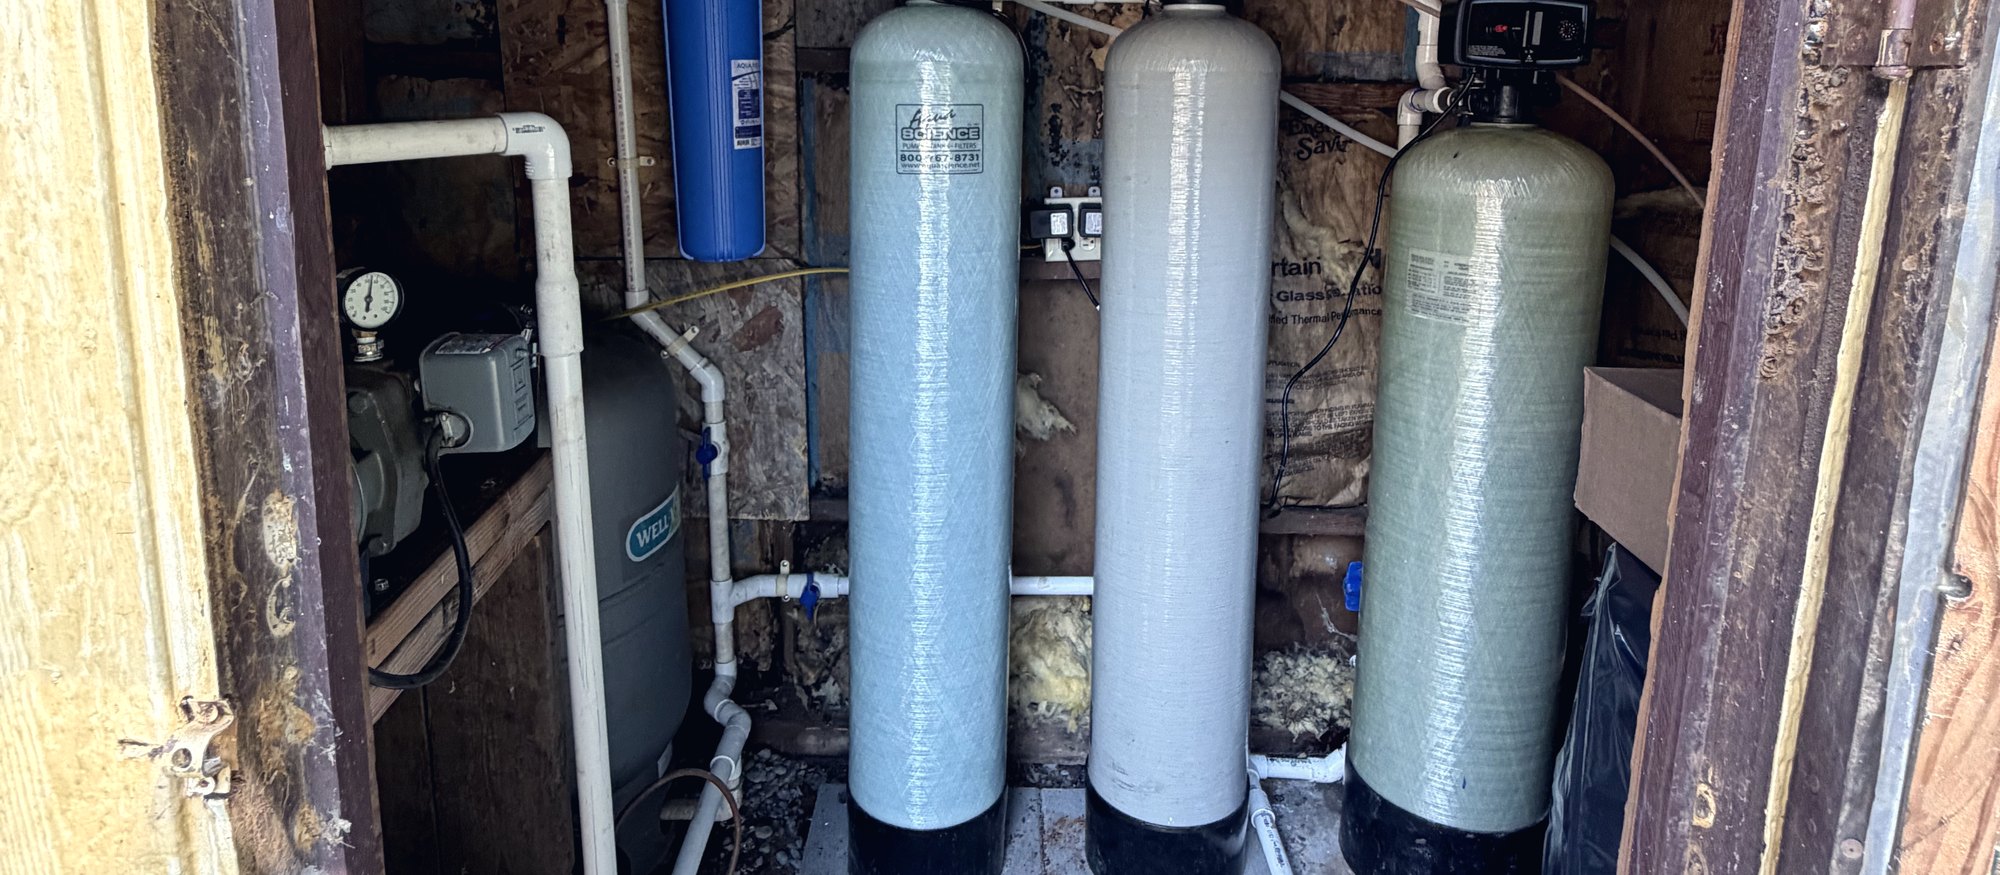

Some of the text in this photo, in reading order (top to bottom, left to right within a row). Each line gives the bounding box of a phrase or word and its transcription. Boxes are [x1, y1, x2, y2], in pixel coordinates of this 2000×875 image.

[901, 127, 981, 141] SCIENCE
[900, 153, 979, 162] 800767-8731
[1271, 256, 1321, 277] rtain
[1276, 289, 1325, 302] Glass
[1291, 313, 1330, 325] Thermal
